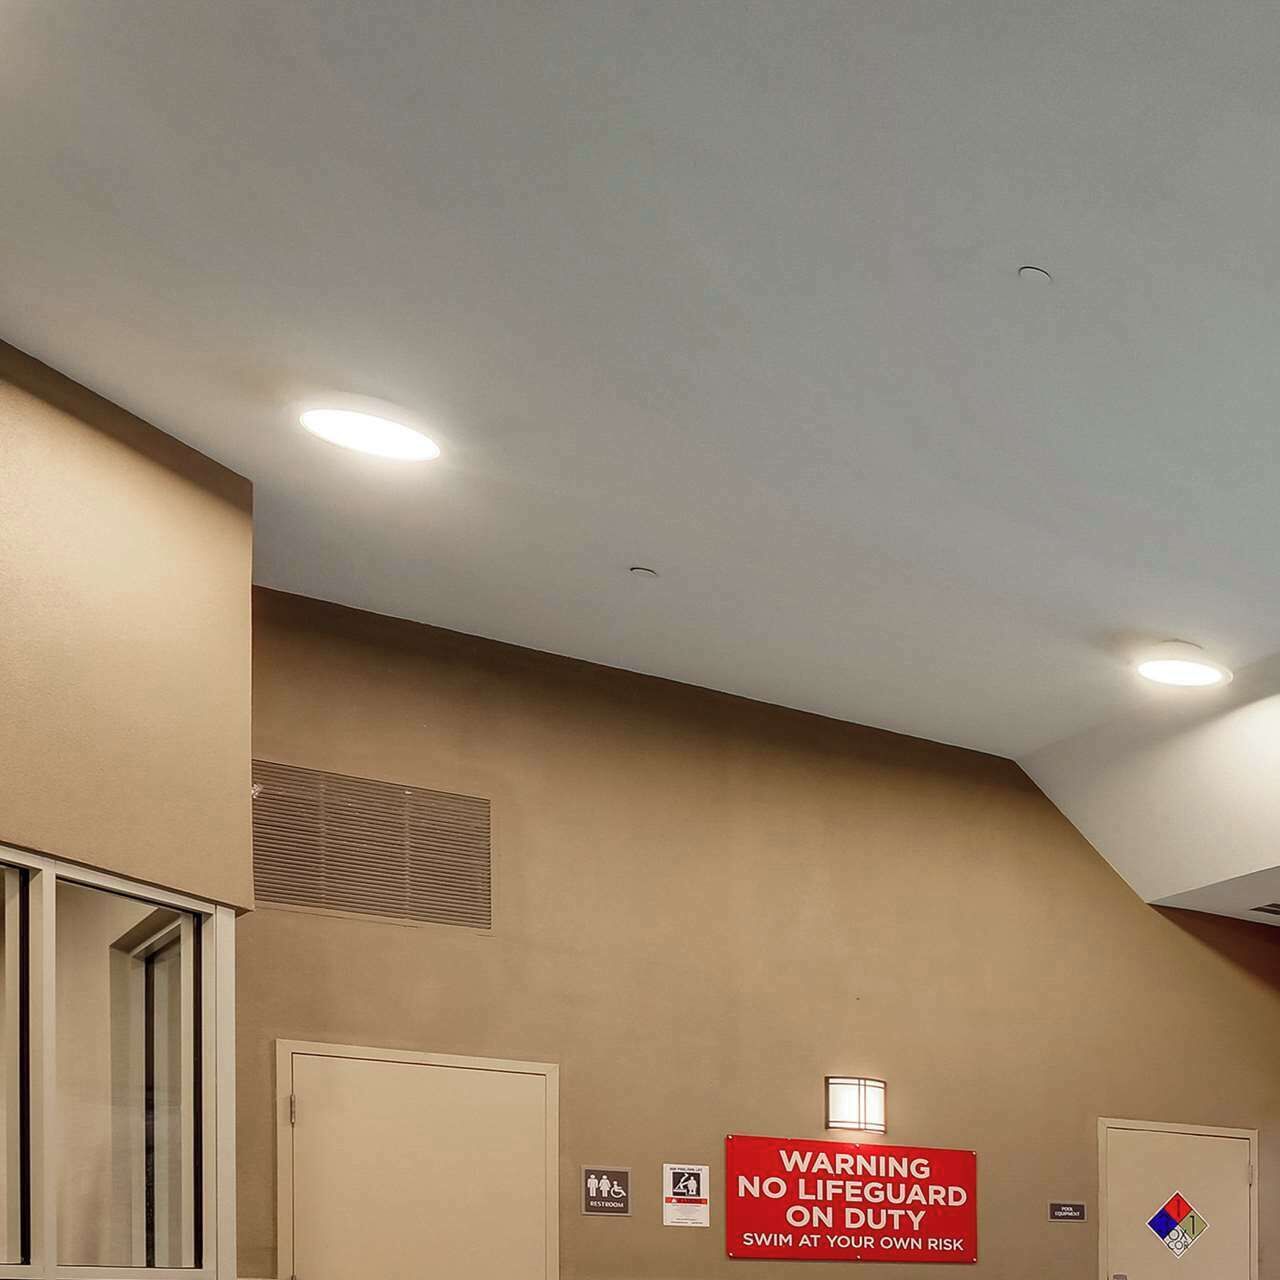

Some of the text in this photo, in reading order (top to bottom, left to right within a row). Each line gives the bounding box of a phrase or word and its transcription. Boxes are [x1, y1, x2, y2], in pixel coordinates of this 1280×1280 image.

[779, 1149, 931, 1179] WARNING
[737, 1175, 967, 1207] NO LIFEGUARD
[590, 1200, 624, 1208] RESTROOM
[785, 1205, 927, 1231] ON DUTY
[1189, 1215, 1195, 1235] 1
[742, 1232, 964, 1251] SWIM AT YOUR OWN RISK
